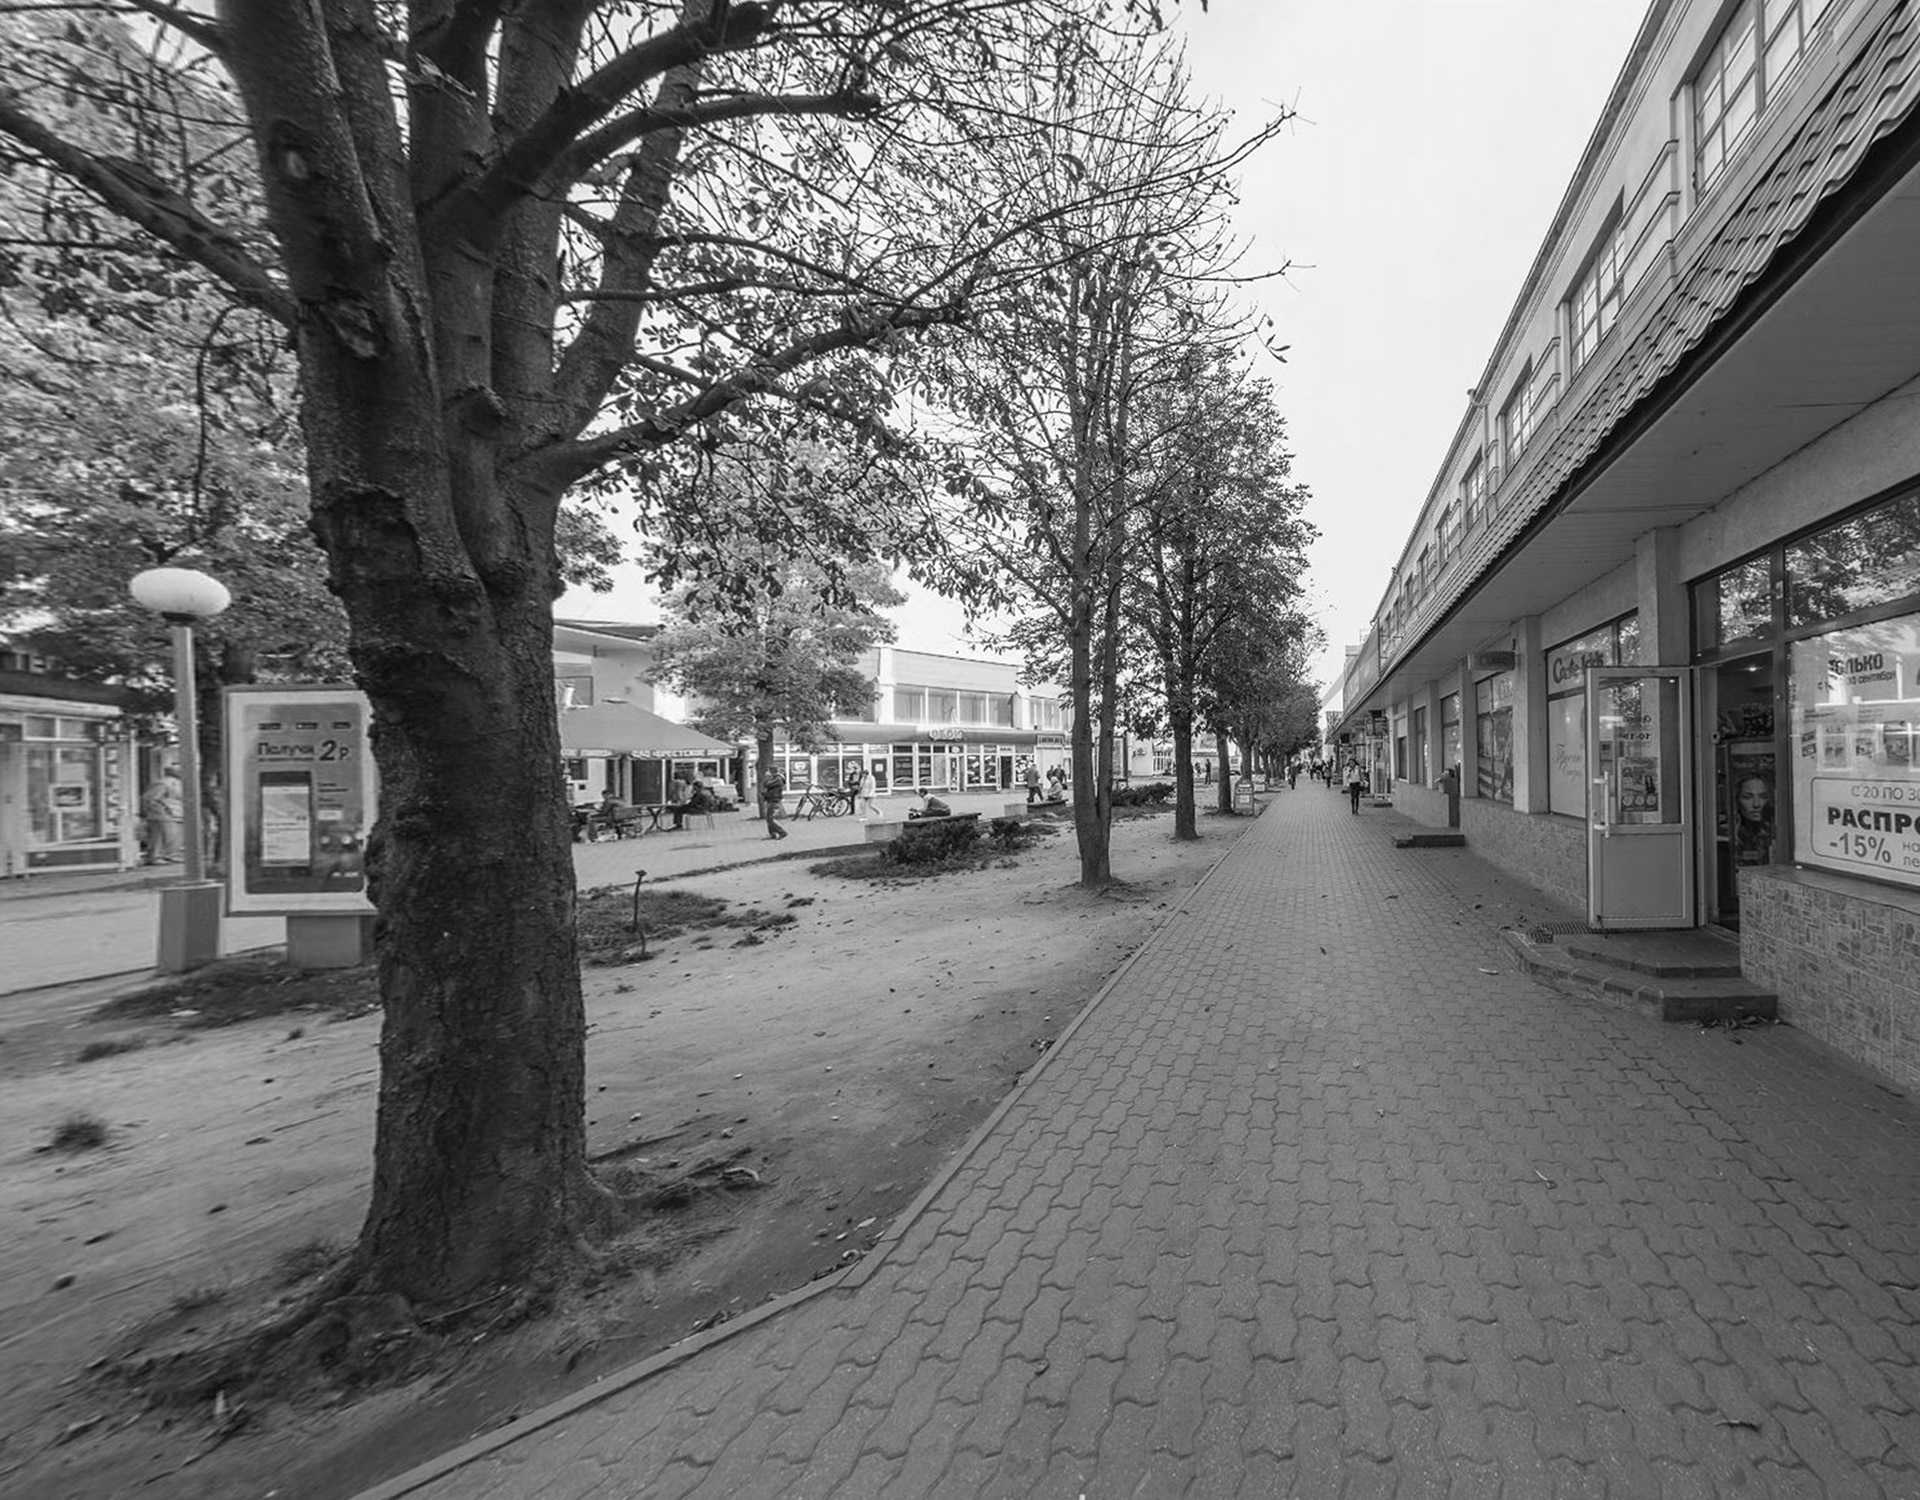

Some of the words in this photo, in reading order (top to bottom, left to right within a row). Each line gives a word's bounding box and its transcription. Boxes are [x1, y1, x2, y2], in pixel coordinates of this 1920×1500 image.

[1862, 786, 1879, 799] 20
[1883, 787, 1904, 801] ПО
[1828, 806, 1920, 837] РАСПР
[1829, 832, 1891, 863] -15%
